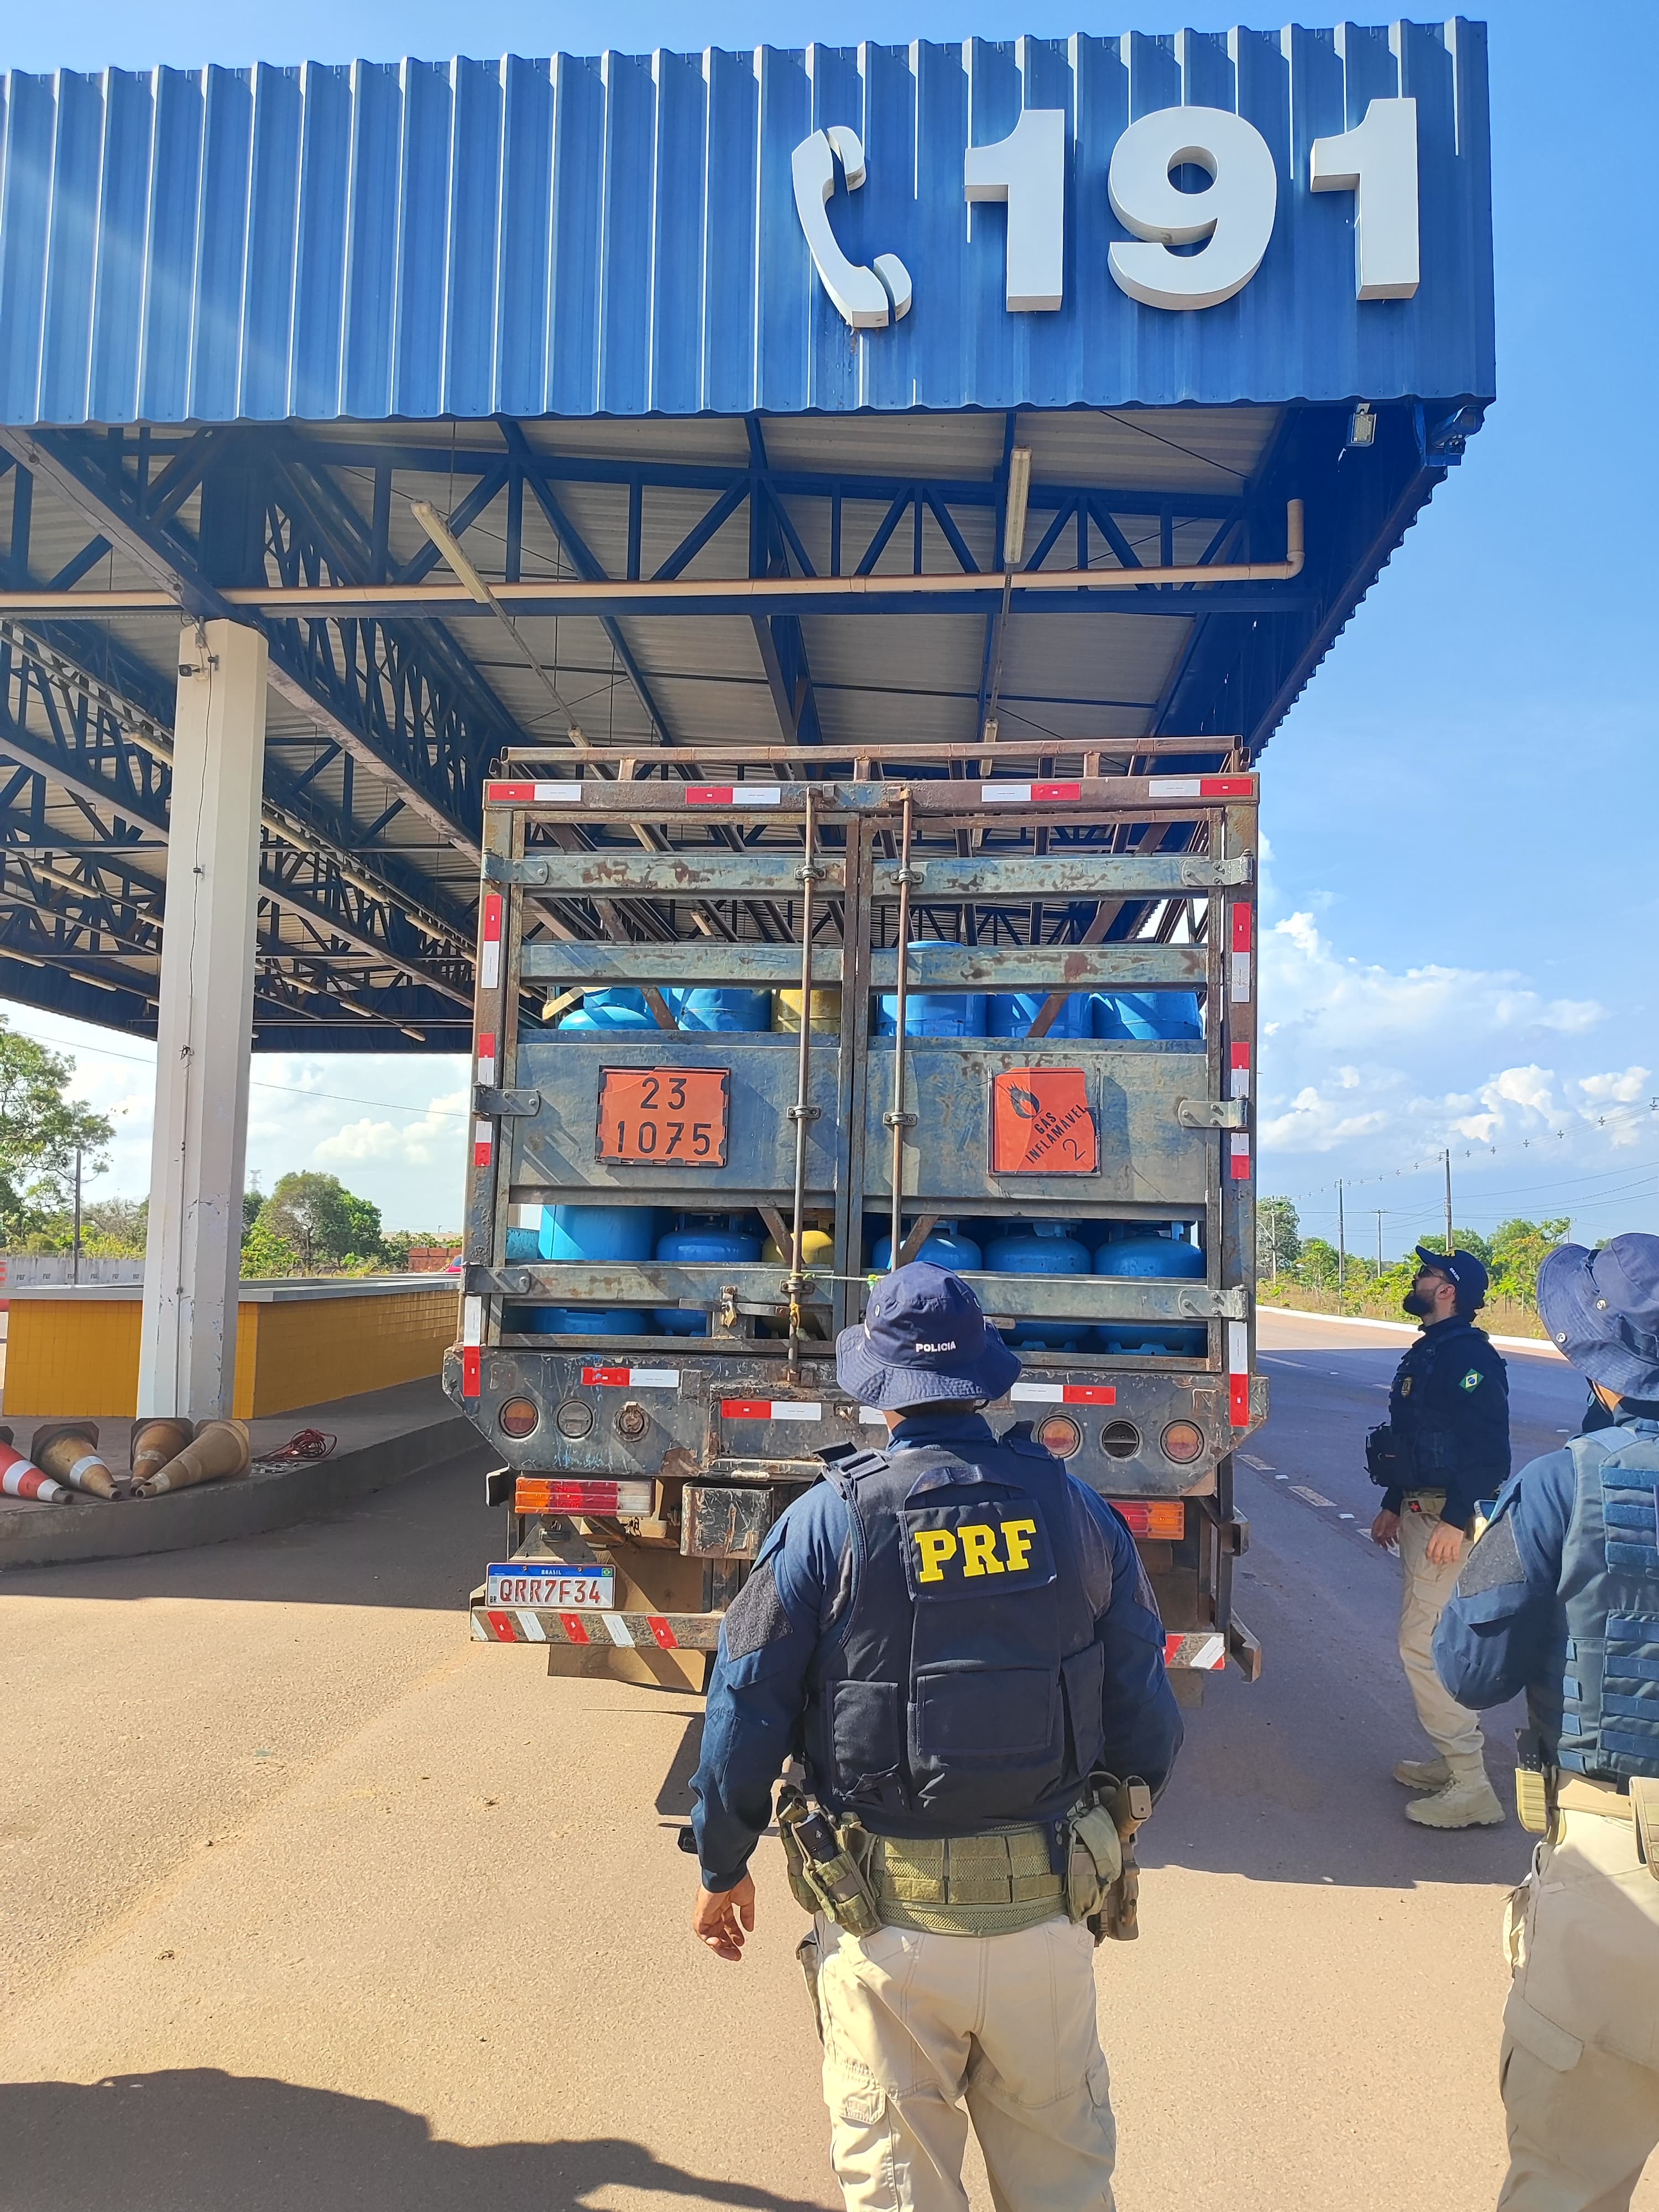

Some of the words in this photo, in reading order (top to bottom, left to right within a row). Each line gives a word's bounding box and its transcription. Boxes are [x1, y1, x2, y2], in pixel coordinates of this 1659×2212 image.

[964, 97, 1420, 312] 191
[640, 1077, 687, 1110] 23
[617, 1120, 712, 1156] 1075
[1025, 1104, 1087, 1164] INFLAMÁVEL
[1034, 1112, 1057, 1135] GÁS
[1062, 1138, 1086, 1161] 2
[915, 1340, 957, 1353] POLICIA
[914, 1519, 1037, 1583] PRF
[499, 1579, 601, 1604] QRR7F34
